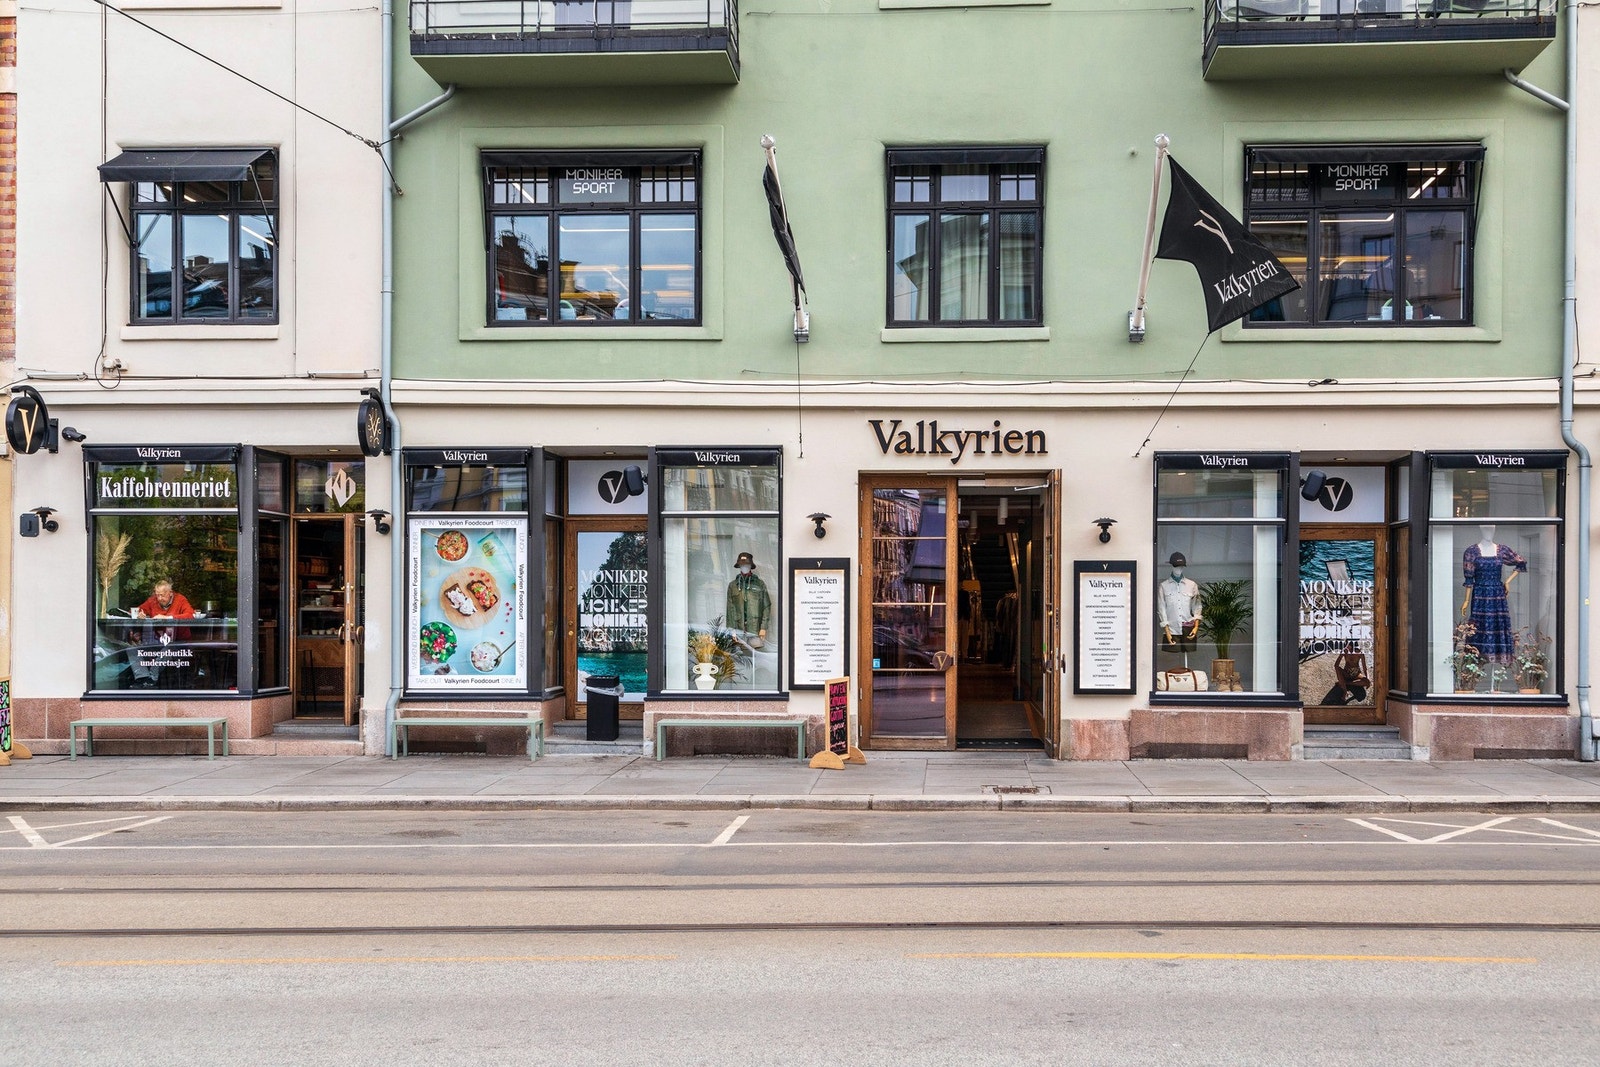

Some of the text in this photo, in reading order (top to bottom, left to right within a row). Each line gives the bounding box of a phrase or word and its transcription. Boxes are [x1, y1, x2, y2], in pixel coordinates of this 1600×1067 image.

[565, 168, 623, 181] MONIKER
[1328, 164, 1388, 177] MONIKER
[573, 182, 615, 194] SPORT
[1335, 178, 1381, 191] SPORT
[1213, 260, 1279, 304] Valkyrien
[867, 419, 1049, 465] Valkyrien
[136, 447, 182, 460] Valkyrien
[442, 450, 488, 464] Valkyrien
[694, 451, 741, 465] Valkyrien
[1200, 454, 1249, 468] Valkyrien
[1474, 454, 1525, 468] Valkyrien
[101, 476, 231, 498] Kaffebrenneriet
[517, 563, 525, 590] Valkyrien
[580, 570, 648, 583] MONIKER
[804, 576, 838, 587] Valkyrien
[580, 584, 648, 598] MONIKER
[1088, 579, 1124, 590] Valkyrien
[1300, 580, 1372, 594] MONIKER
[580, 599, 648, 613] MONIKER
[1300, 594, 1372, 609] MONIKER
[580, 613, 648, 627] MONIKER
[580, 628, 648, 642] MONIKER
[1300, 625, 1372, 639] MONIKER
[137, 649, 193, 659] Konseptbutikk
[1300, 640, 1372, 654] MONIKER
[140, 658, 190, 669] underetasjen
